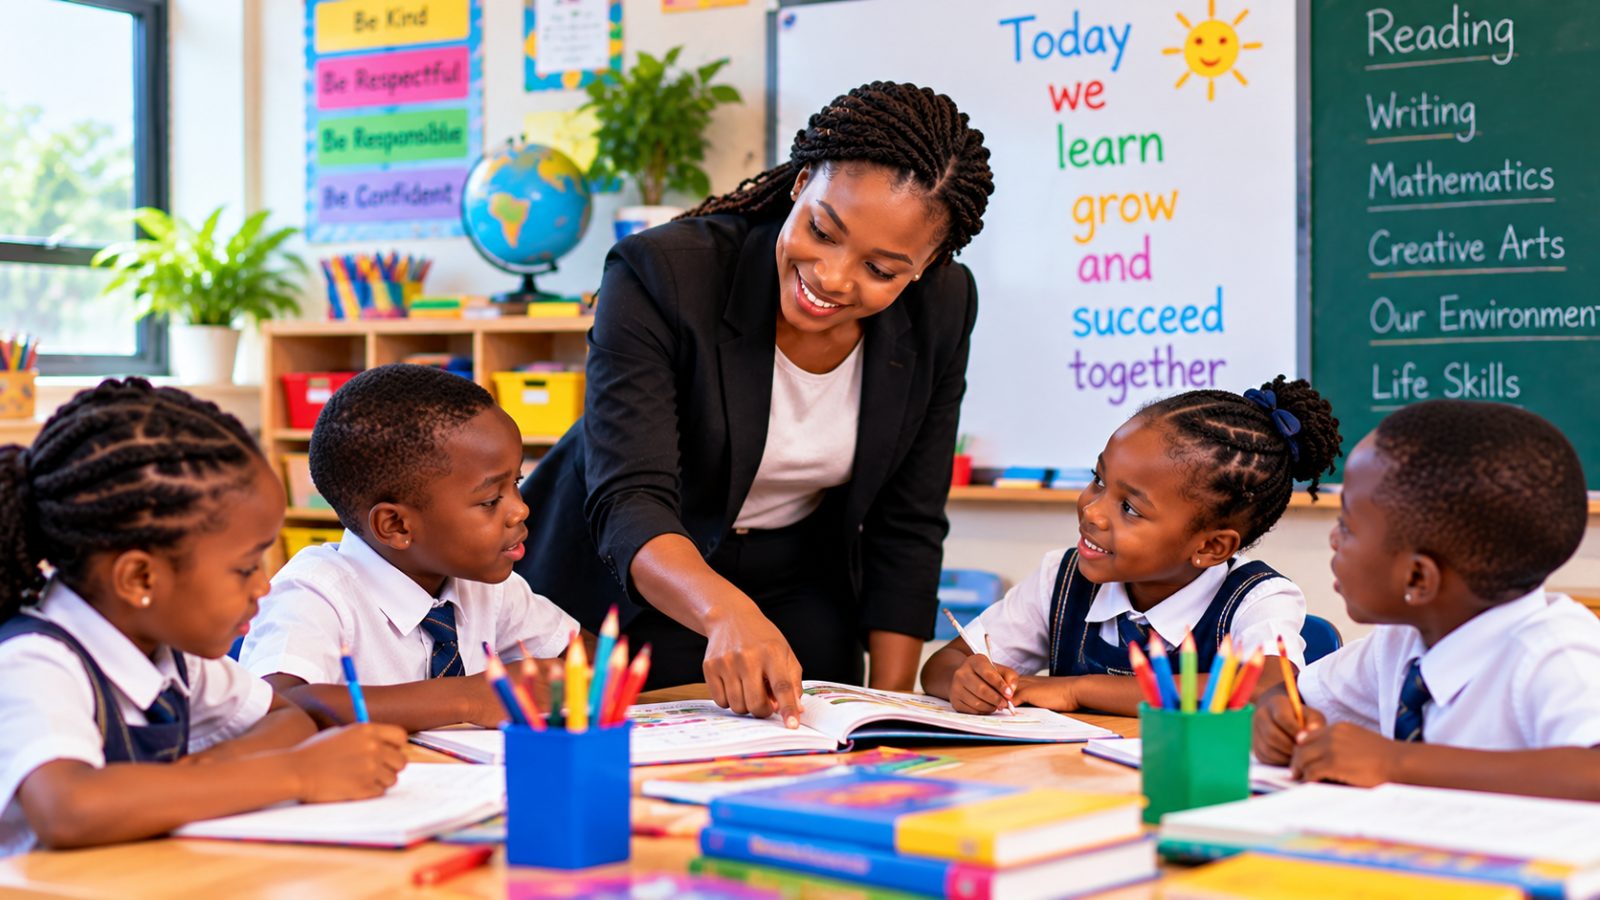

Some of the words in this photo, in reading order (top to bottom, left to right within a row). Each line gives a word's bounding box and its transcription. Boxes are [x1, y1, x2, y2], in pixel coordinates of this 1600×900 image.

[354, 11, 377, 32] Be
[387, 5, 428, 27] Kind
[1366, 3, 1514, 65] Reading
[998, 10, 1132, 72] Today
[323, 72, 346, 94] Be
[355, 59, 461, 95] Respectful
[1048, 79, 1106, 112] we
[322, 128, 347, 153] Be
[353, 121, 462, 155] Responsible
[1366, 91, 1476, 142] Writing
[1057, 123, 1164, 170] learn
[323, 185, 347, 210] Be
[354, 182, 453, 209] Confident
[1368, 158, 1554, 200] Mathematics
[1071, 189, 1179, 244] grow
[1077, 234, 1153, 284] and
[1367, 229, 1485, 267] Creative
[1498, 223, 1566, 261] Arts
[1072, 285, 1225, 338] succeed
[1369, 296, 1426, 335] Our
[1439, 294, 1600, 332] Environmen
[1068, 344, 1227, 406] together
[1371, 362, 1429, 400] Life
[1443, 361, 1521, 400] Skills
